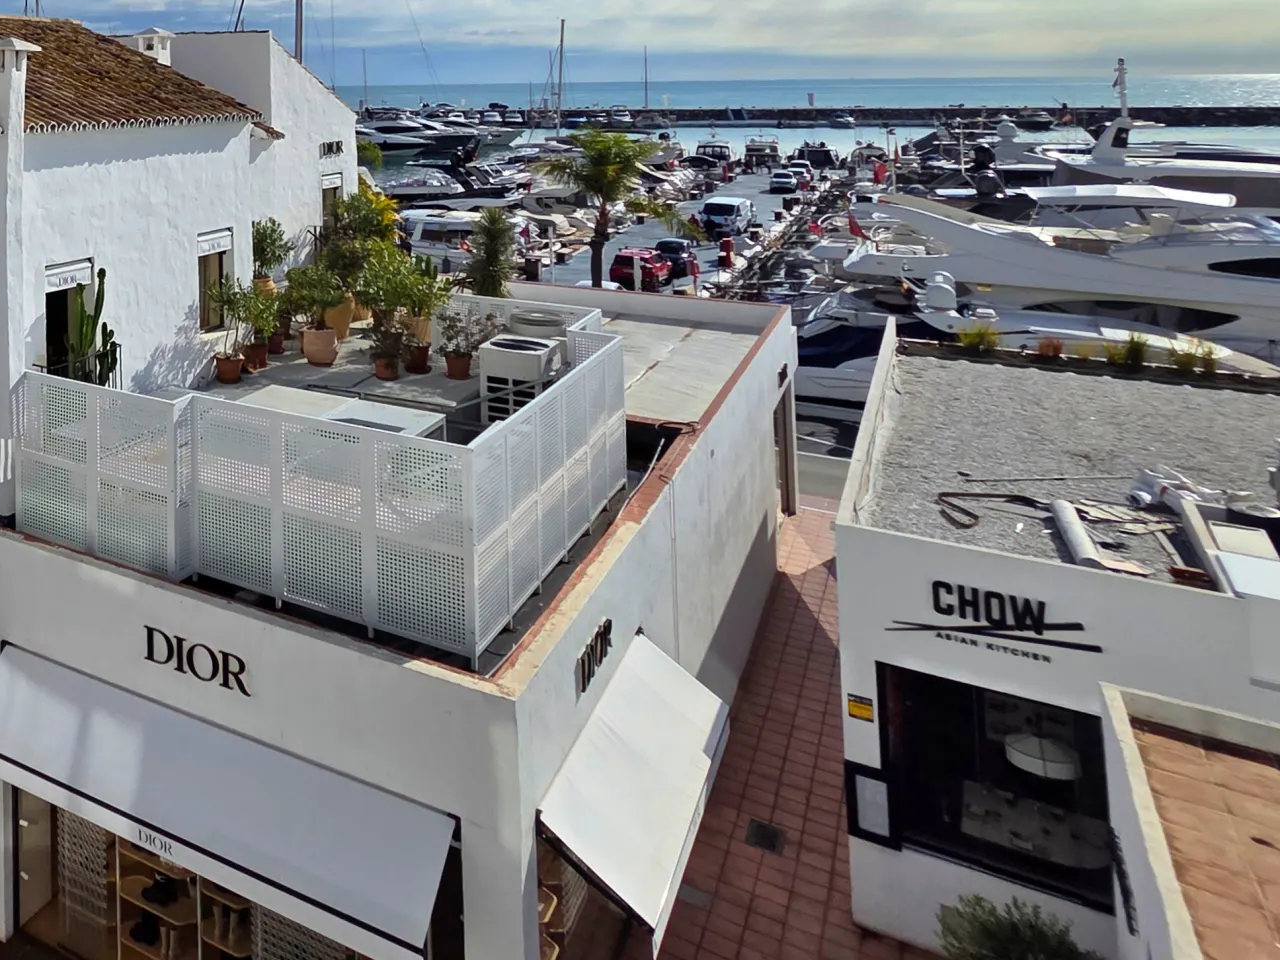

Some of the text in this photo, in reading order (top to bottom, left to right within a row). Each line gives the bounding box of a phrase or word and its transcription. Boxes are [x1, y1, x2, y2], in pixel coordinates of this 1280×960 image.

[322, 140, 344, 156] DIOR
[932, 580, 1046, 636] CHOW
[143, 624, 252, 698] DIOR
[580, 618, 613, 693] DIOR
[935, 632, 1052, 664] ASIAN KITCHEN
[137, 827, 173, 857] DIOR
